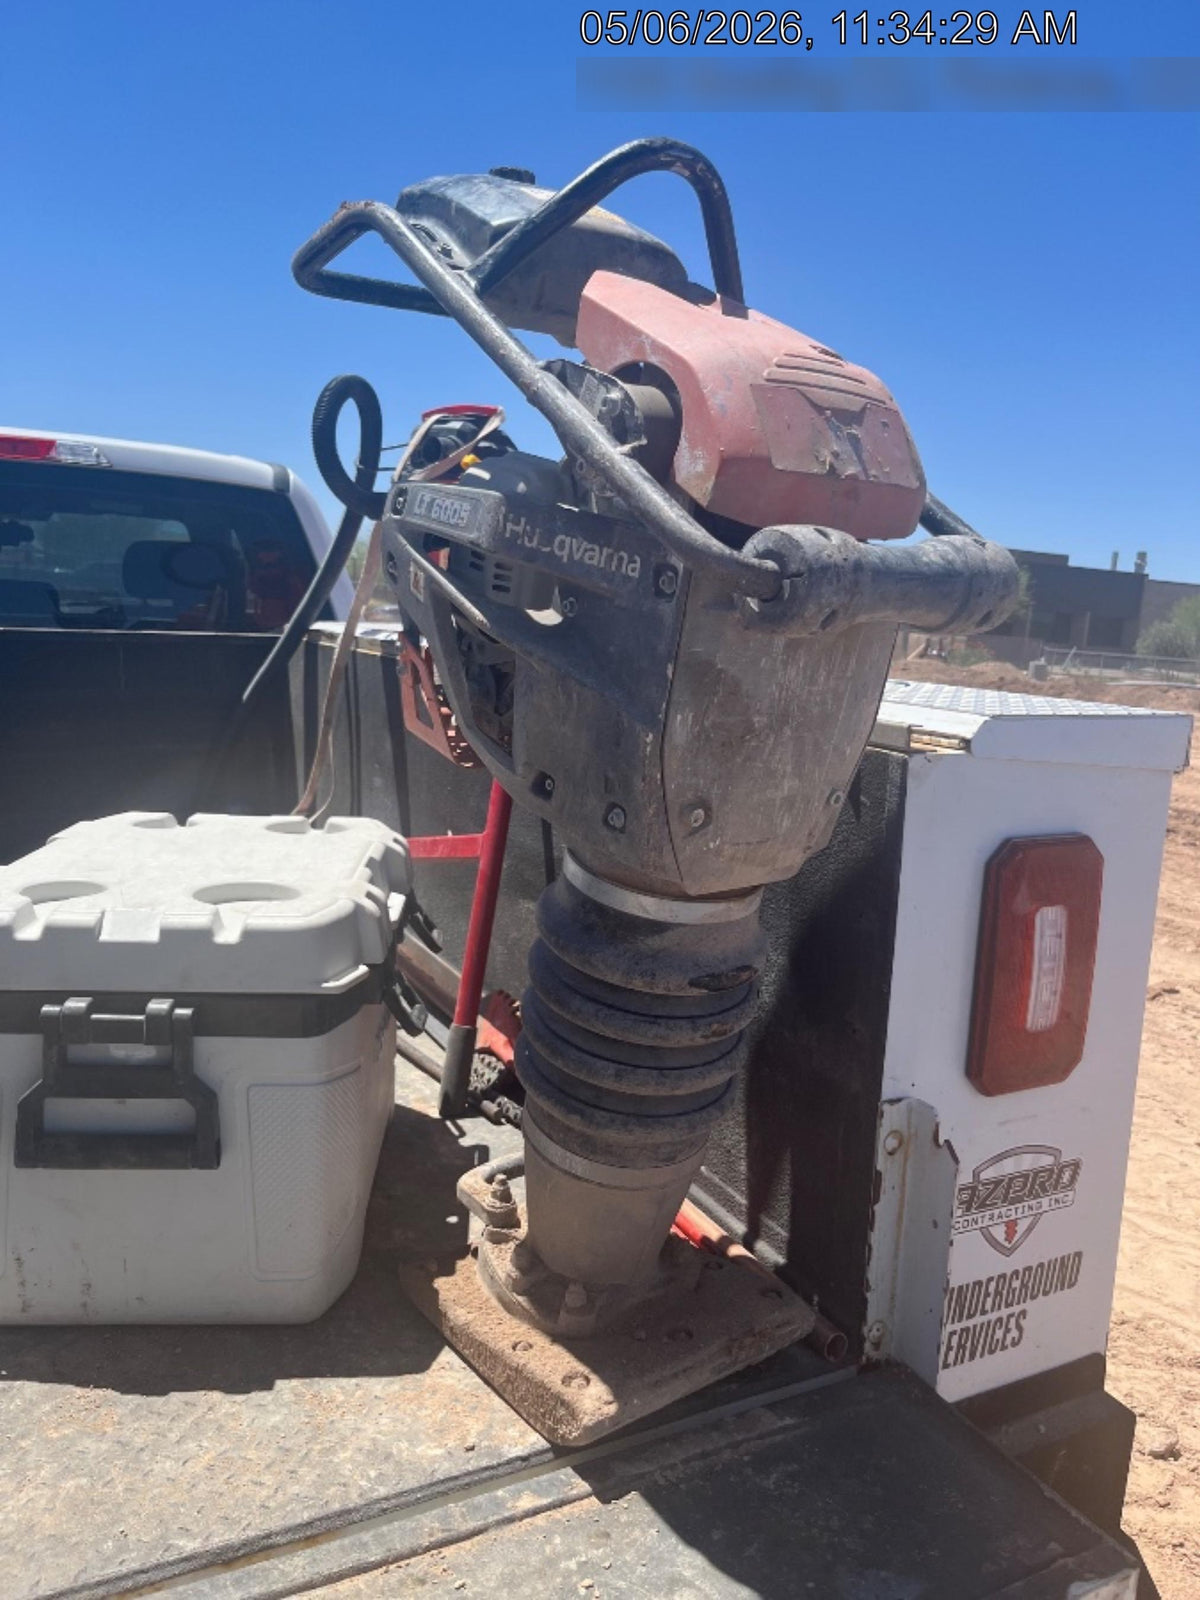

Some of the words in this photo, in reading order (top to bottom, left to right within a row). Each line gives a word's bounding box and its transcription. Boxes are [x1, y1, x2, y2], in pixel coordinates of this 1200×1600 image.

[505, 516, 641, 578] Huqvarna
[952, 1201, 1043, 1231] CONTRACTING
[941, 1308, 1028, 1371] ERVICES
